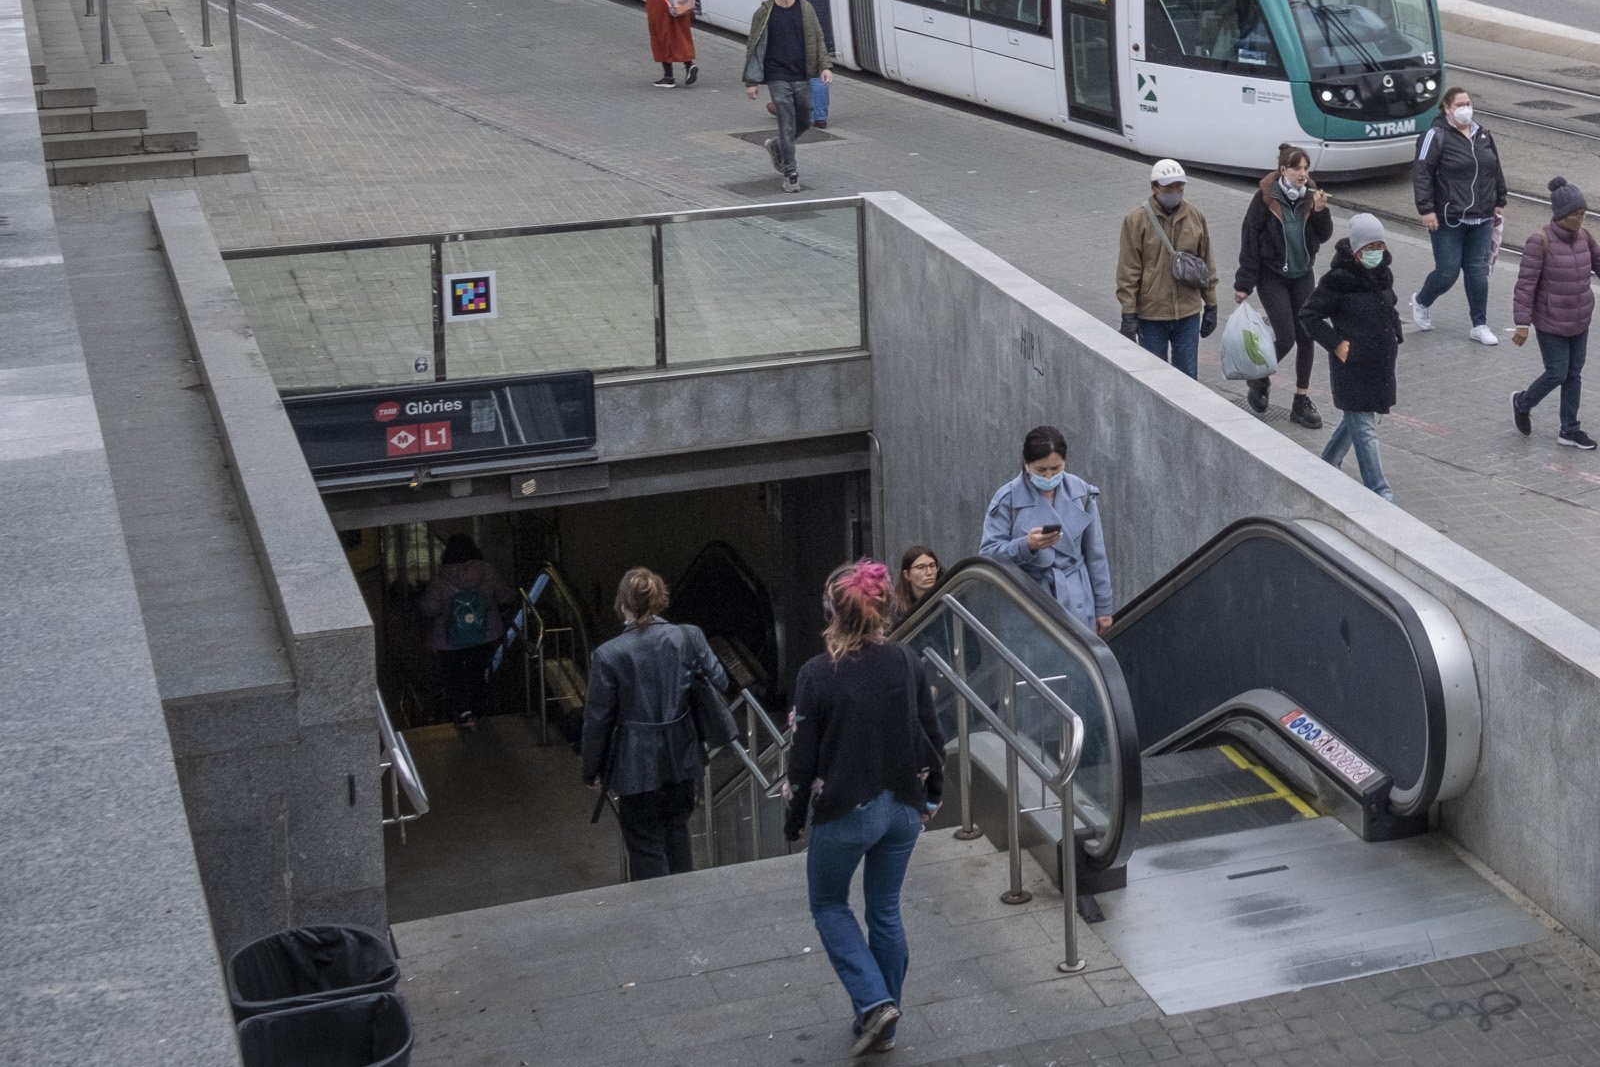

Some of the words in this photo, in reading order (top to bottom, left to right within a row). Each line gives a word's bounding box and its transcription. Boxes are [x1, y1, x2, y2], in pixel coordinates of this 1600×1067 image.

[1421, 52, 1436, 65] 15
[1139, 104, 1158, 114] TRAM
[1378, 119, 1416, 135] TRAM
[405, 399, 463, 416] Glòries
[397, 434, 409, 445] M
[425, 427, 446, 446] L1
